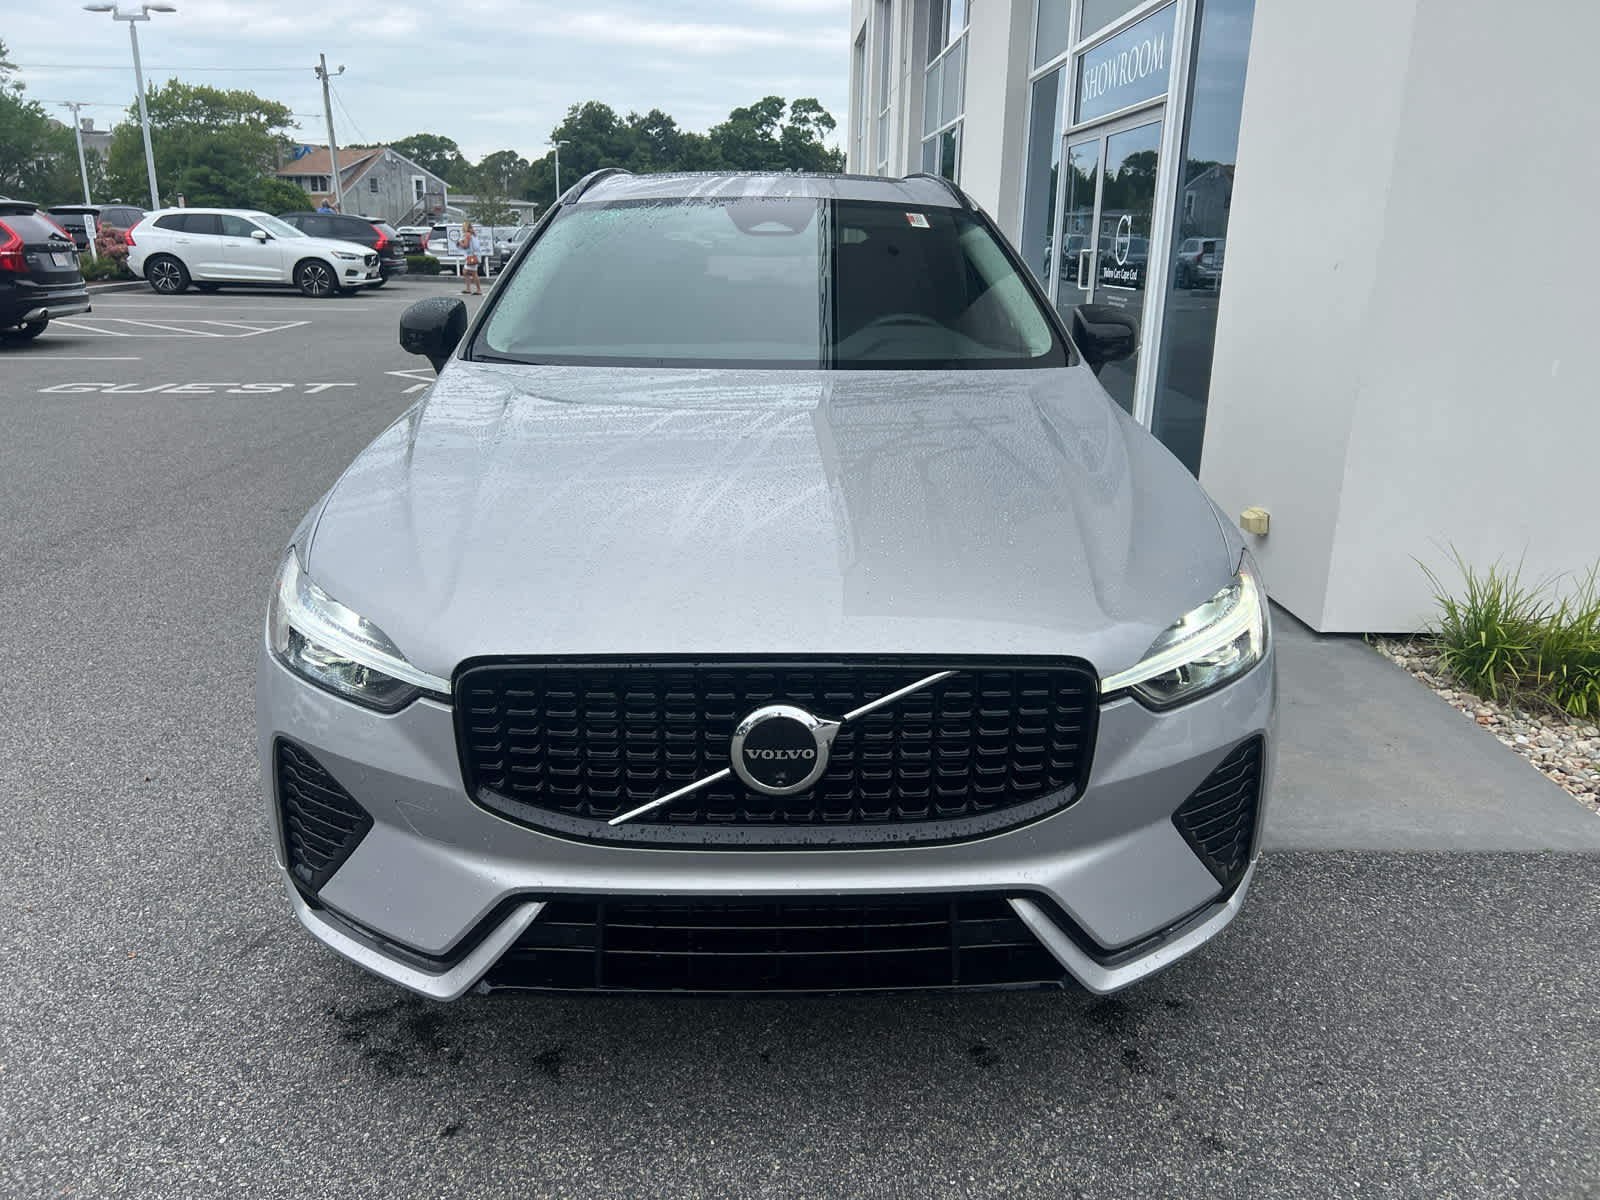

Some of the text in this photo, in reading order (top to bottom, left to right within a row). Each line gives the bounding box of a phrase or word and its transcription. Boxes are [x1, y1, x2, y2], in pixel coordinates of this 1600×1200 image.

[1082, 32, 1165, 102] SHOWROOM
[37, 382, 357, 394] GUEST
[744, 748, 815, 760] VOLVO
